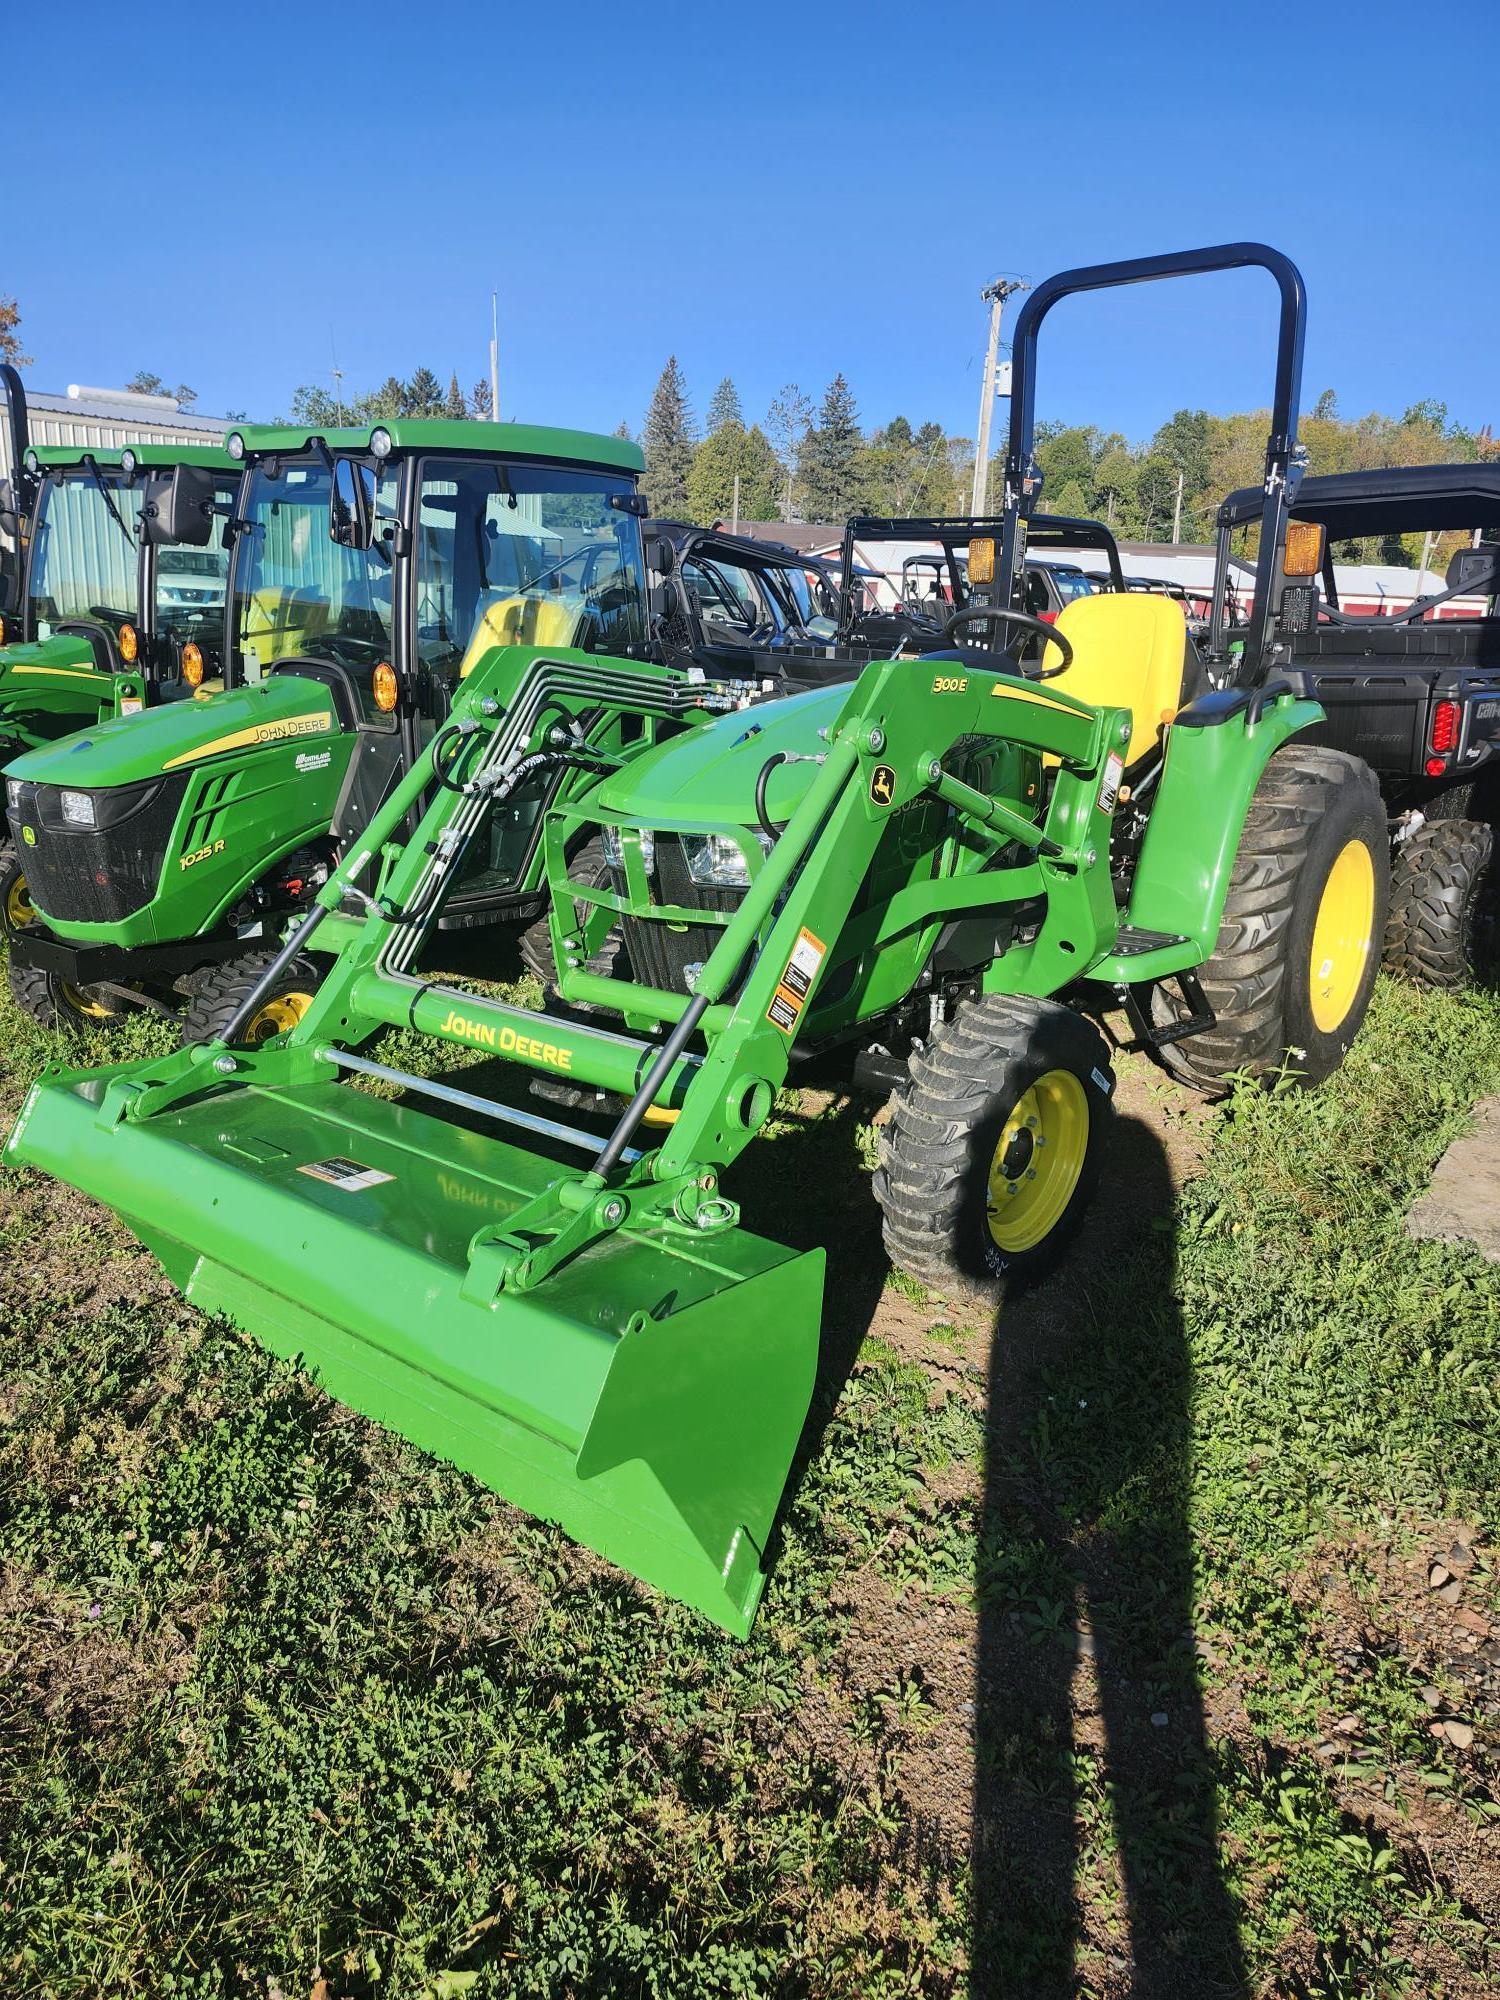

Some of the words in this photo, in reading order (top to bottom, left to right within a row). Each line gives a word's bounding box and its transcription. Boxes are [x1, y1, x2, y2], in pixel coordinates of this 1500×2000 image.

[933, 677, 968, 693] 300E
[1476, 703, 1500, 719] can-
[254, 726, 286, 742] JOHN
[288, 720, 327, 735] DEERE
[440, 1010, 496, 1046] JOHN
[500, 1026, 573, 1070] DEERE
